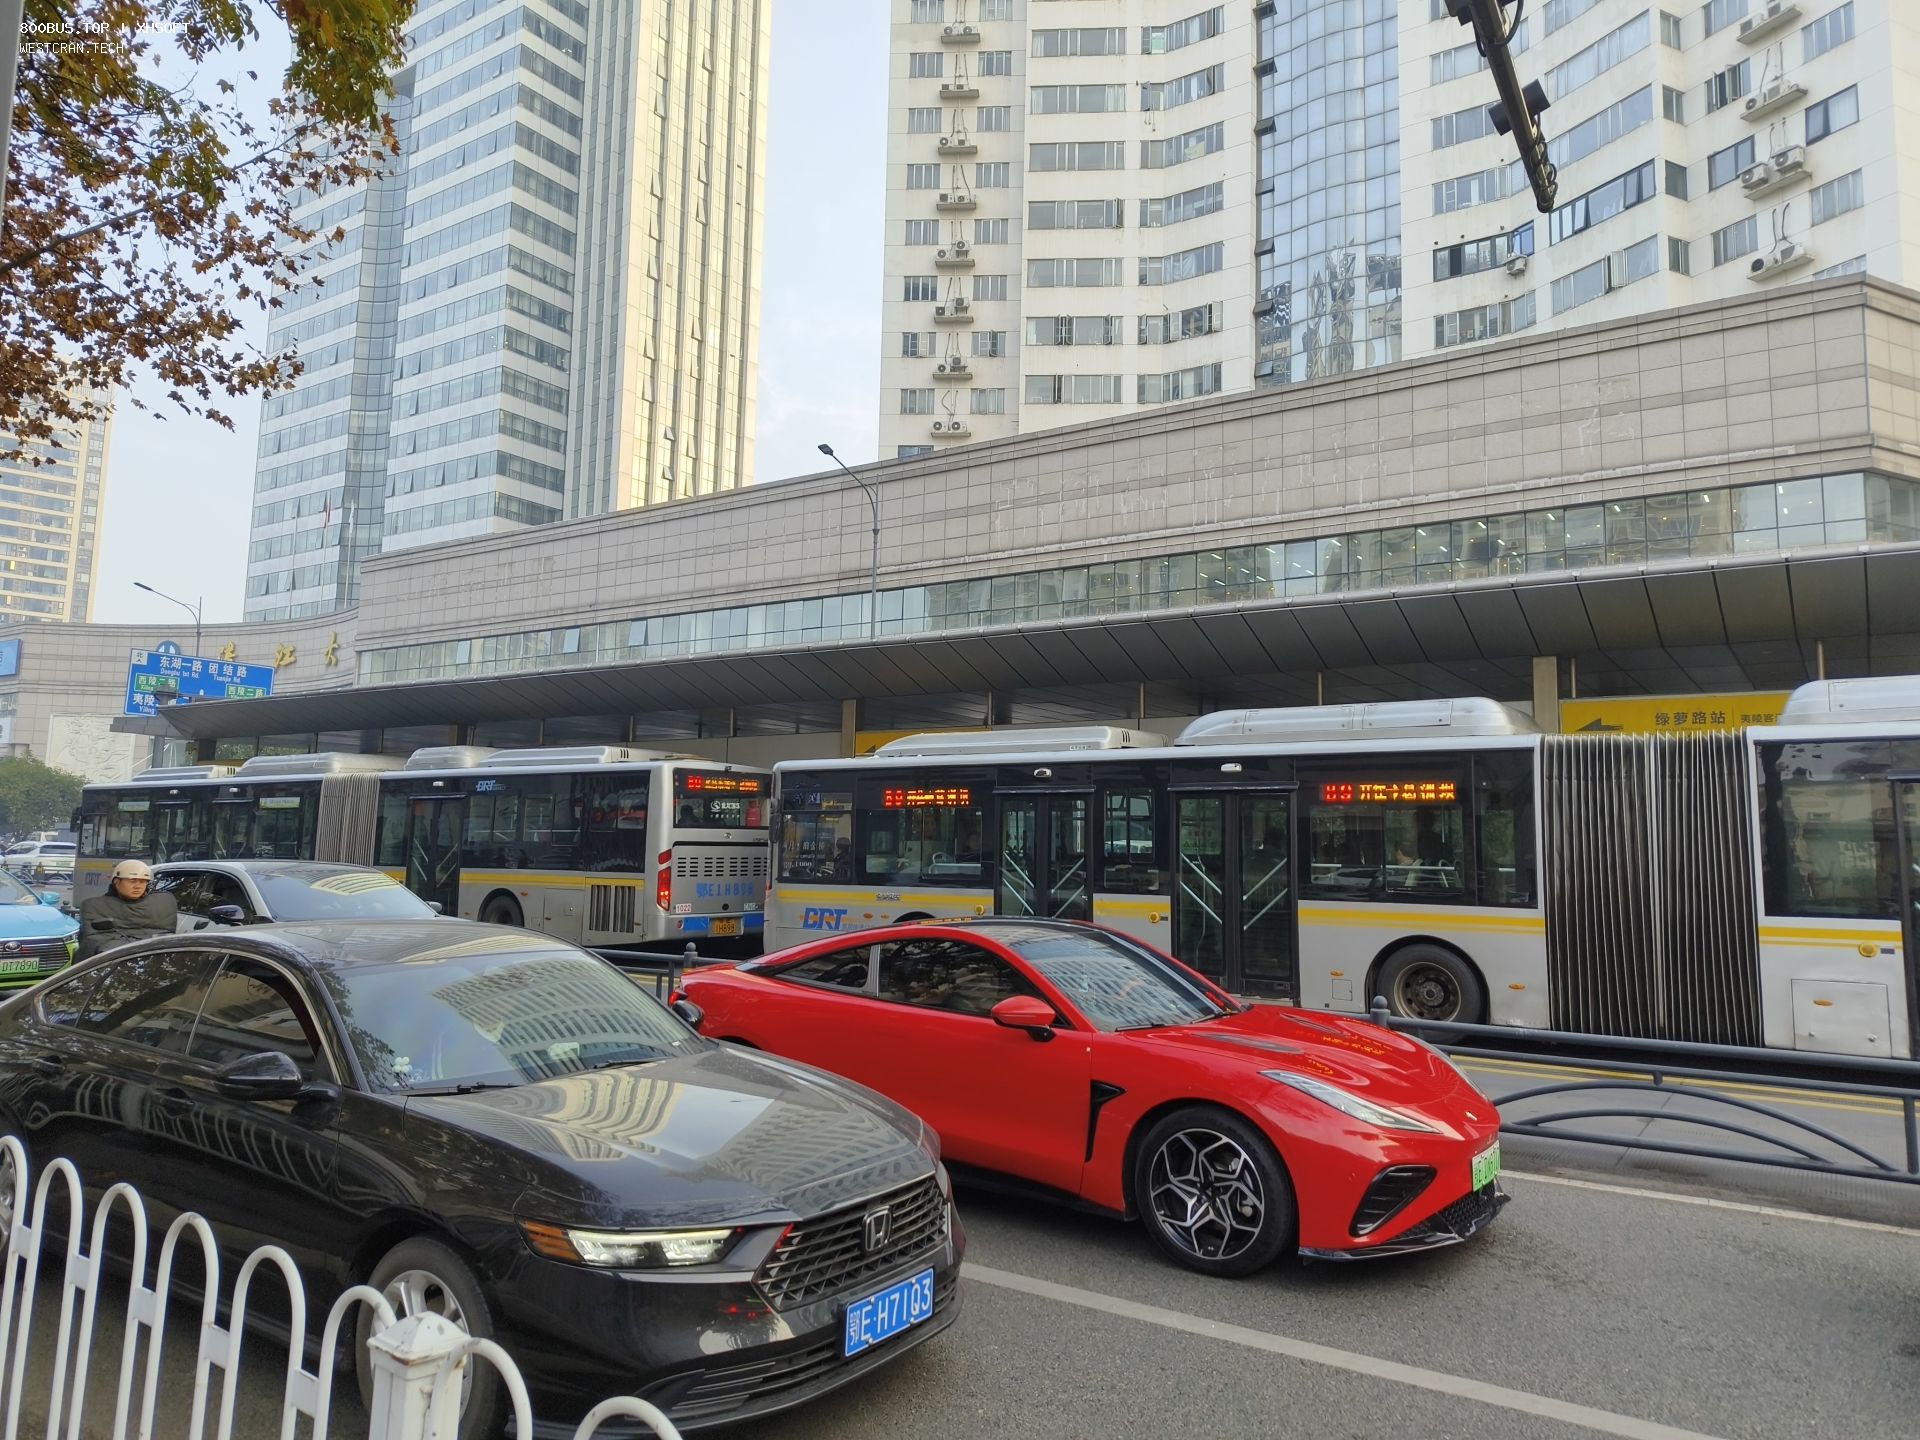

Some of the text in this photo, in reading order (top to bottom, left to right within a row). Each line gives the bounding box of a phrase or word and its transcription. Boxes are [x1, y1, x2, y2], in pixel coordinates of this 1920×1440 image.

[160, 656, 248, 678] 东湖一路 团结路
[1655, 711, 1726, 726] 绿萝路站
